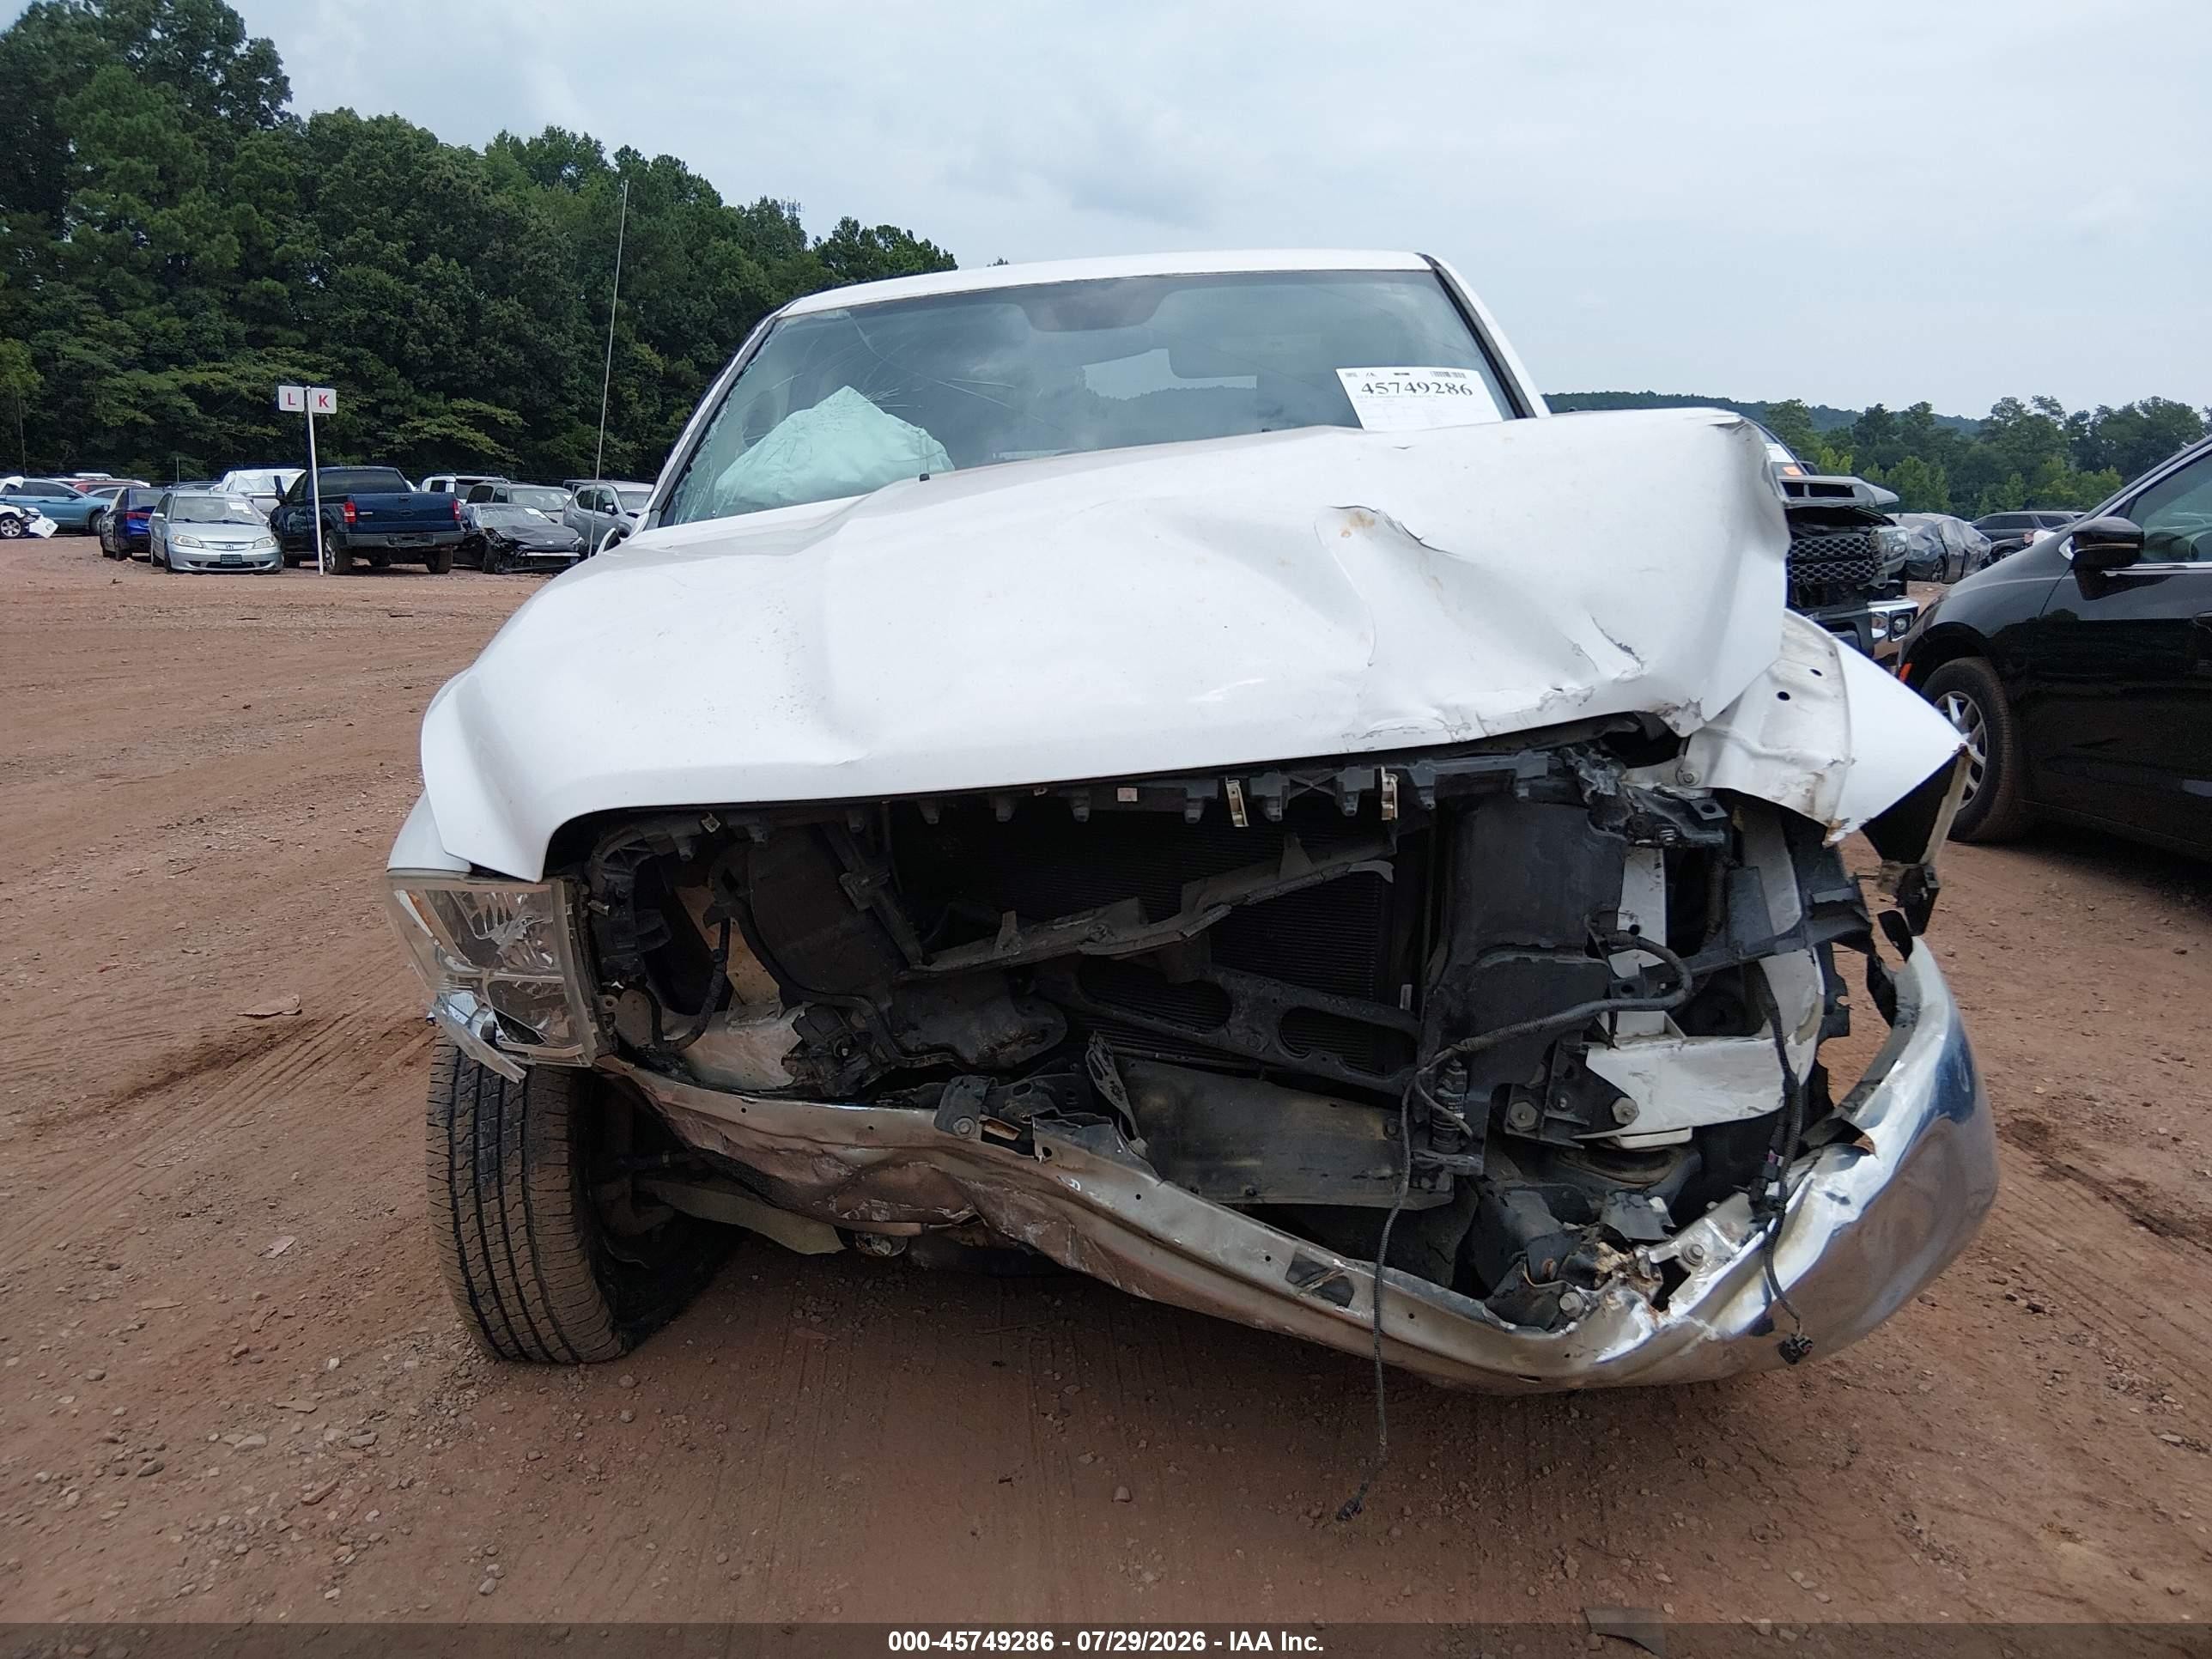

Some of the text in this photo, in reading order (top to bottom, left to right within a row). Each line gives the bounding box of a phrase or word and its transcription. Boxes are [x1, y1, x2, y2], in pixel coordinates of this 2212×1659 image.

[1361, 381, 1474, 397] 45749286
[287, 392, 296, 406] L
[318, 394, 330, 408] K
